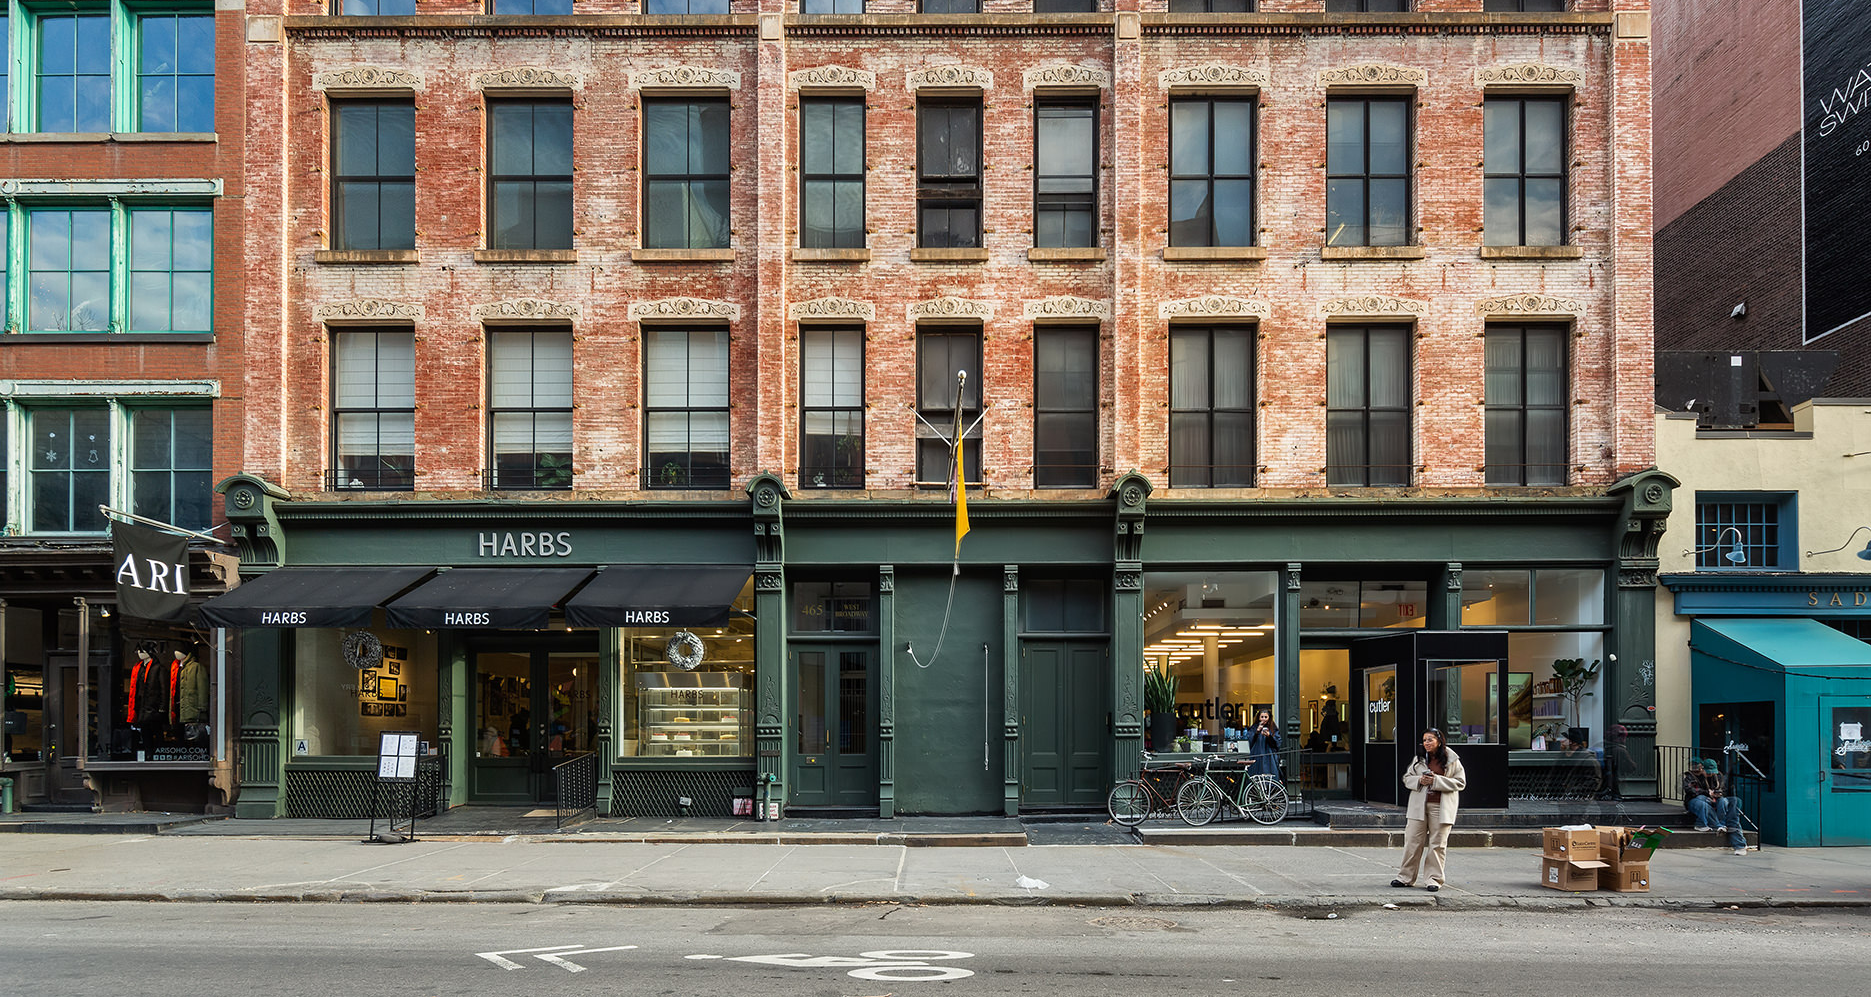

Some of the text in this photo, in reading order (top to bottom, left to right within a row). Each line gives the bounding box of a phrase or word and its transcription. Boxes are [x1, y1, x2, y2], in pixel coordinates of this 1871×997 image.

[1820, 63, 1871, 114] WA
[1819, 87, 1871, 137] SWI
[479, 532, 573, 557] HARBS
[116, 553, 188, 595] ARI
[1808, 592, 1867, 606] SAD
[625, 610, 670, 624] HARBS
[801, 604, 823, 616] 465
[261, 611, 307, 625] HARBS
[445, 612, 490, 625] HARBS
[670, 689, 704, 699] HARBS
[1178, 696, 1244, 720] cutler
[1369, 698, 1391, 713] cutler
[297, 741, 306, 751] A
